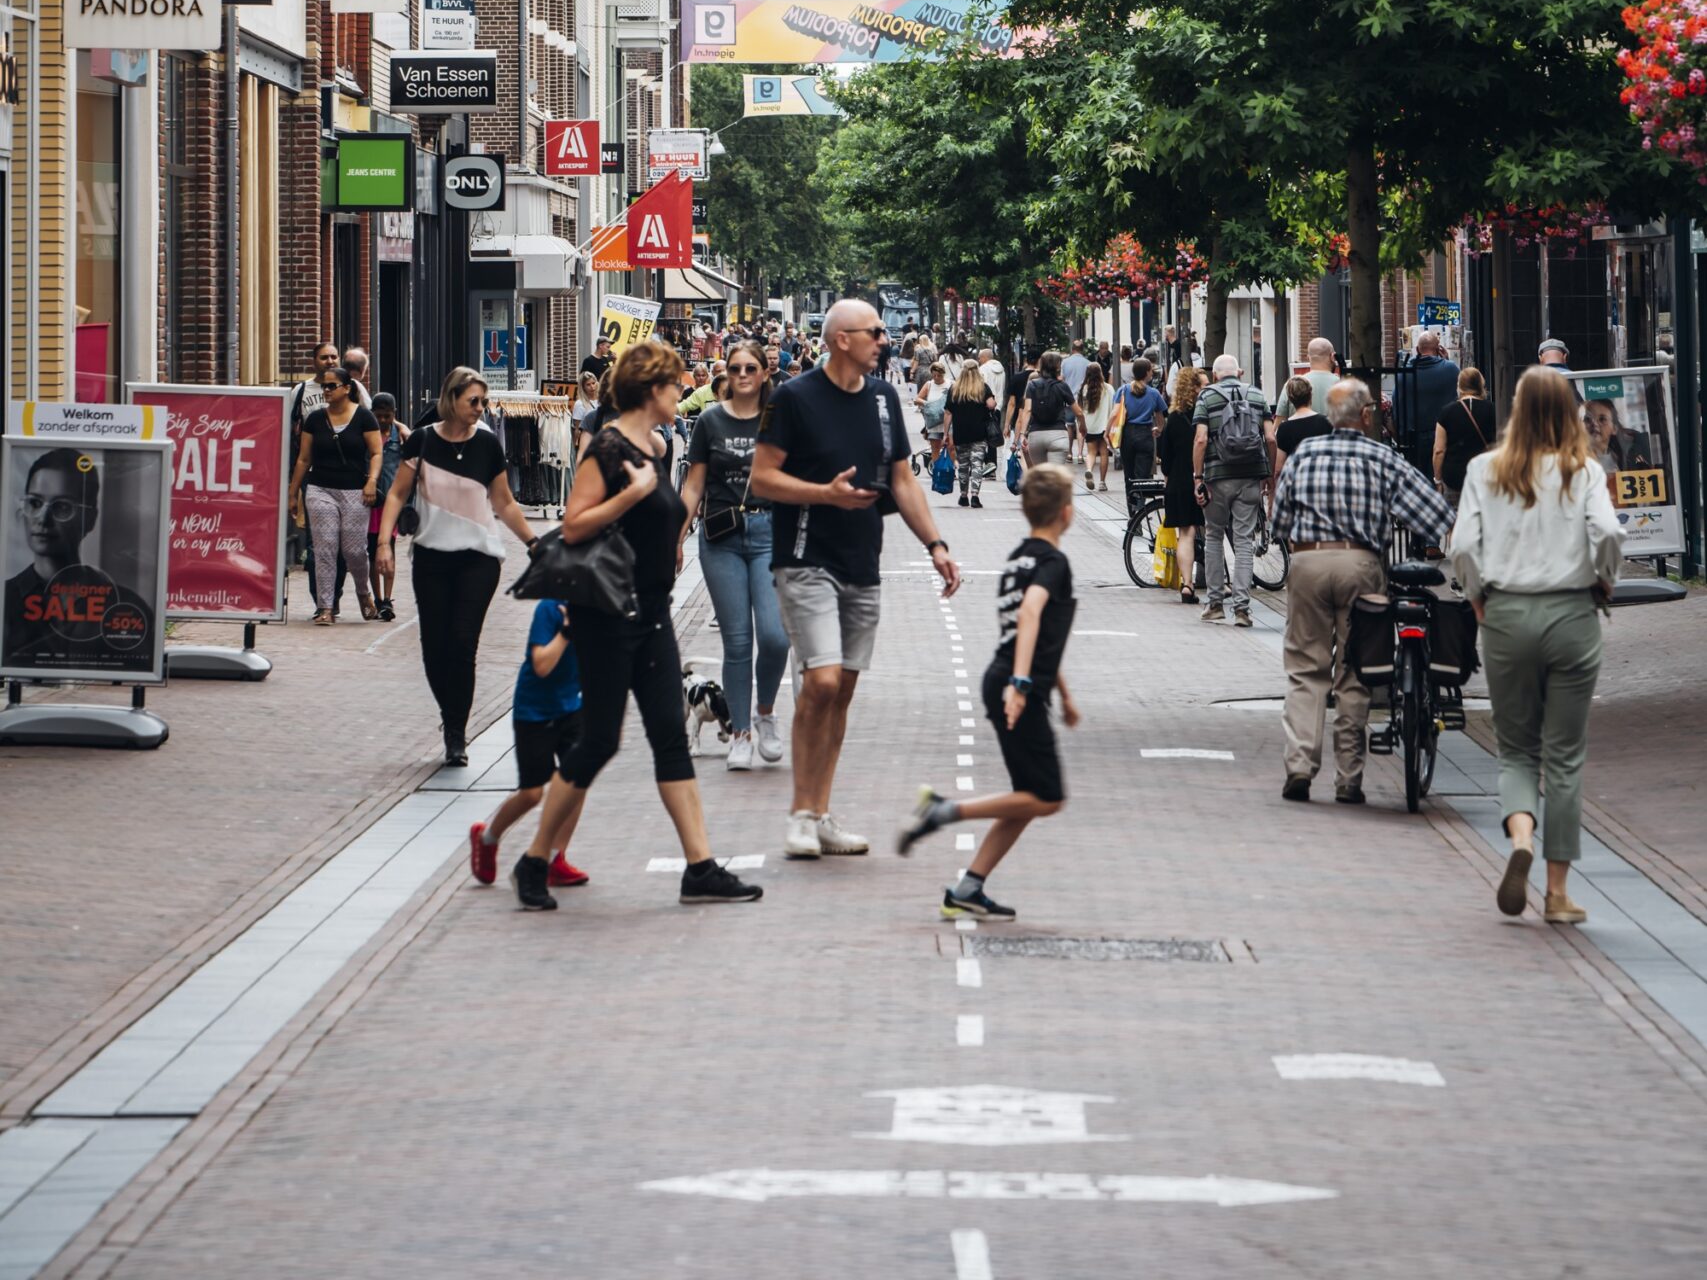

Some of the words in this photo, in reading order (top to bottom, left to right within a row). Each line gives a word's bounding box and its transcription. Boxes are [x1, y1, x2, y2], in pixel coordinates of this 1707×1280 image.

[442, 17, 464, 25] HUUR
[399, 66, 431, 81] Van
[436, 66, 488, 81] Essen
[405, 83, 488, 98] Schoenen
[446, 176, 497, 189] ONLY
[302, 392, 326, 409] AUTH
[62, 408, 114, 421] Welkom
[38, 421, 80, 432] zonder
[83, 422, 137, 435] afspraak
[192, 414, 234, 440] Sexy
[1622, 474, 1638, 500] 3
[1648, 474, 1660, 497] 1
[173, 538, 187, 549] or
[215, 536, 245, 553] later
[51, 583, 113, 597] designer
[23, 594, 107, 622] SALE
